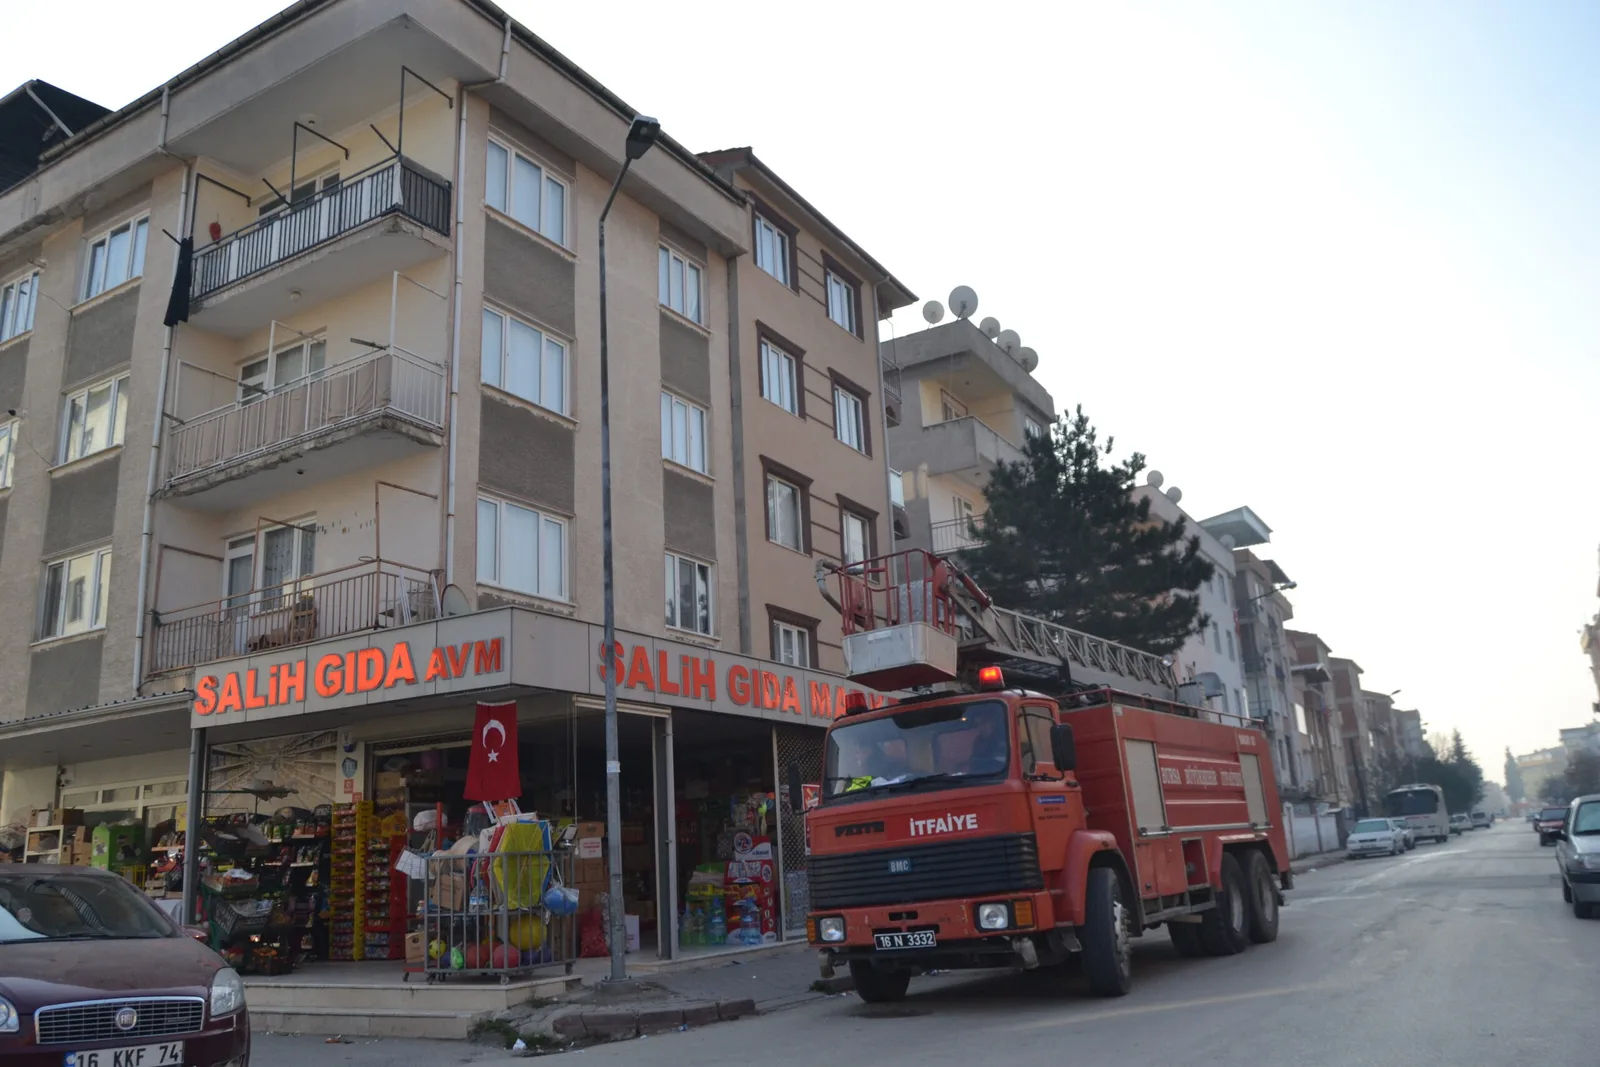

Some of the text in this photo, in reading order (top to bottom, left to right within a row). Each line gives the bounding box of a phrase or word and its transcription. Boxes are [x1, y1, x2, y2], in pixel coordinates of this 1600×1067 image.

[314, 642, 416, 698] GIDA
[424, 637, 504, 682] AVM
[727, 664, 803, 715] GIDA
[890, 860, 909, 872] BMC
[880, 933, 934, 947] 16 N 3332
[77, 1044, 179, 1067] 16 KKF 74
